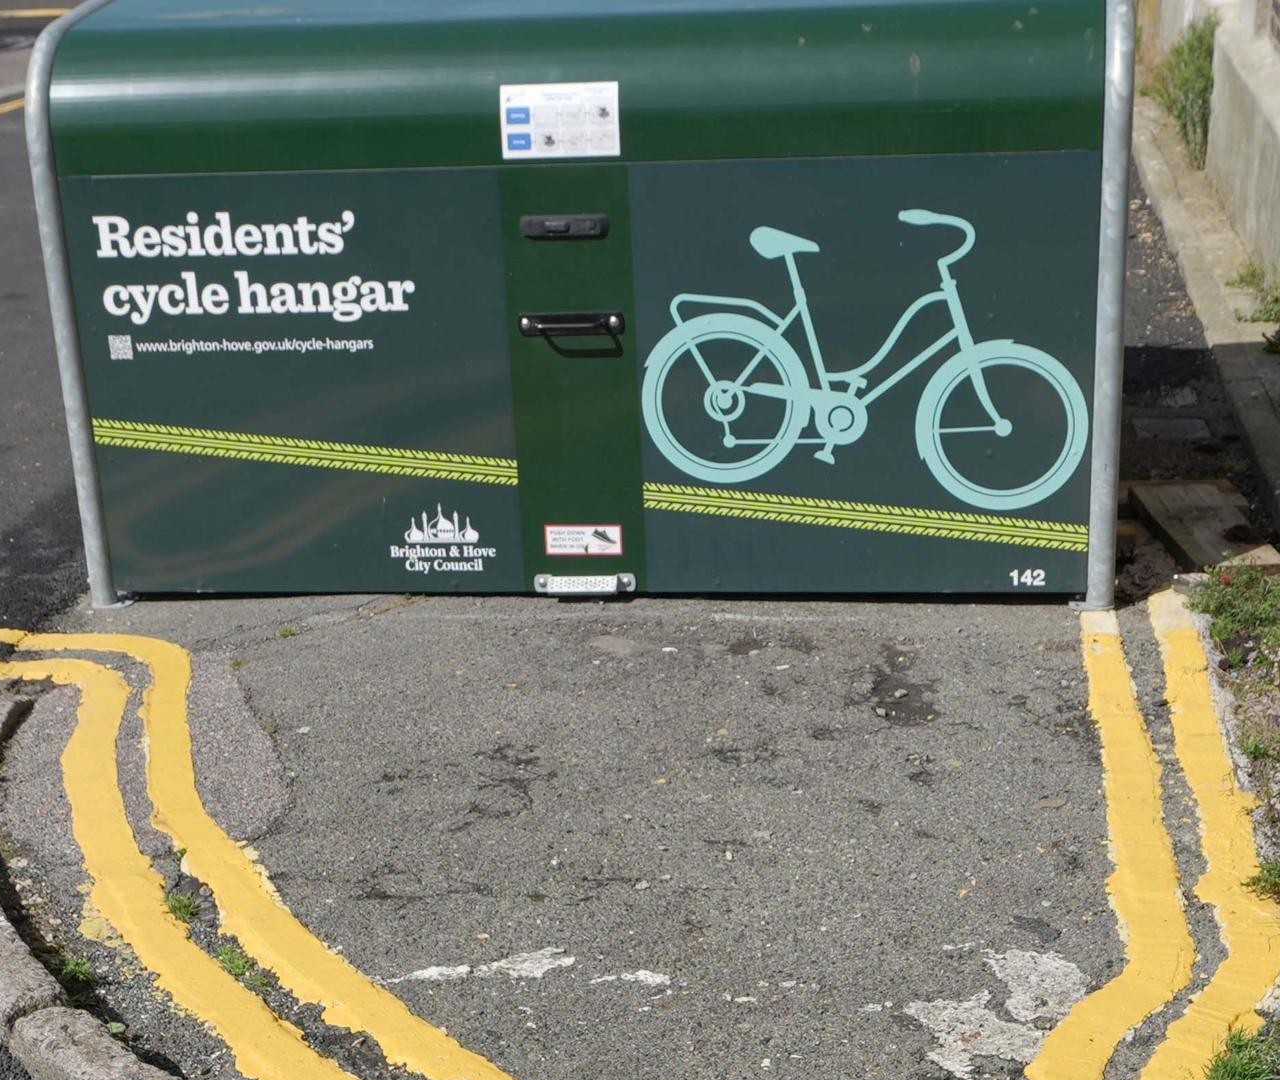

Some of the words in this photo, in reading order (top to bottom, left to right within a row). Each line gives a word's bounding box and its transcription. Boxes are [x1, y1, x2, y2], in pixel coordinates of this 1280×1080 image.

[92, 210, 354, 258] Residents’
[103, 271, 229, 325] cycle
[234, 271, 415, 322] hangar
[136, 338, 373, 354] www.brighton-hove.gov.uk/cycle-hangars
[390, 545, 447, 560] Brighton
[449, 545, 460, 557] &
[463, 545, 496, 557] Hove
[405, 559, 431, 574] City
[433, 558, 484, 571] Council
[1010, 569, 1045, 586] 142
